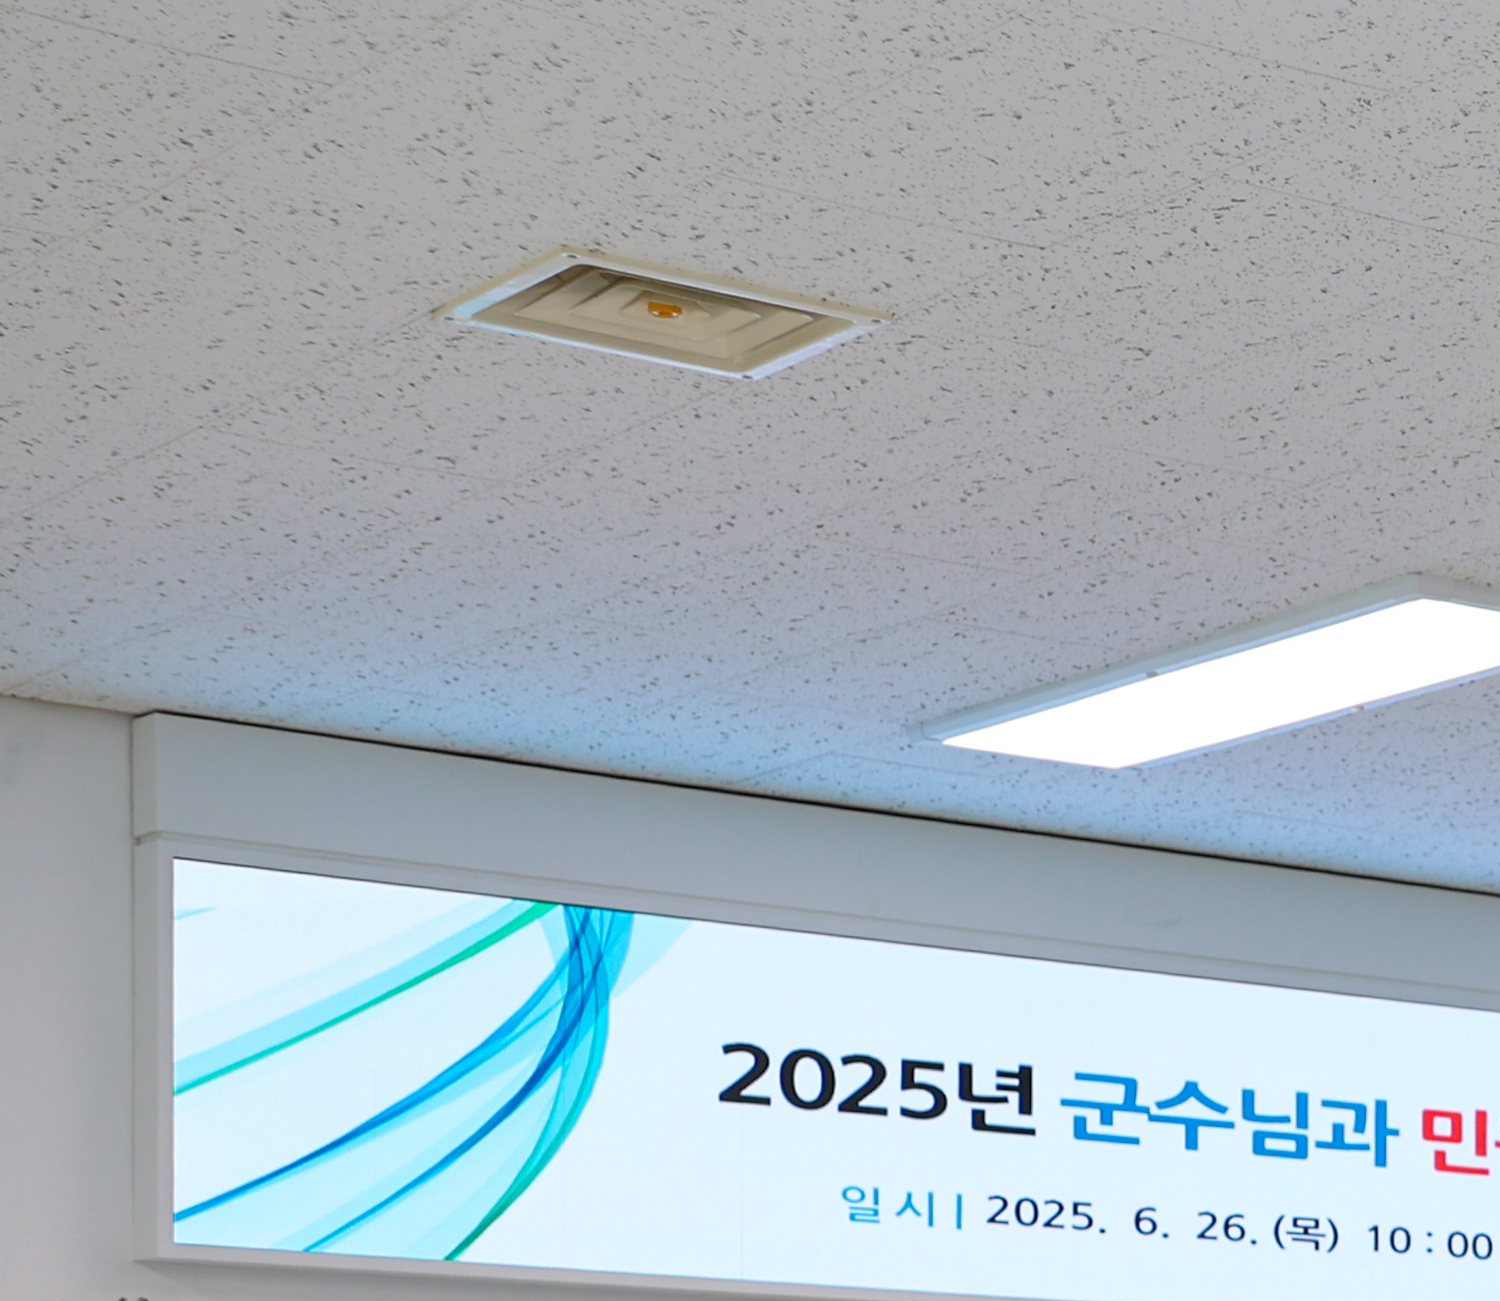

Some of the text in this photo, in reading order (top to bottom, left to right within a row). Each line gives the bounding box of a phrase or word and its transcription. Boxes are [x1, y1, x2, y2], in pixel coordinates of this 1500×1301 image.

[718, 1041, 1037, 1137] 2025년
[1059, 1071, 1401, 1169] 군수님과
[986, 1194, 1106, 1234] 2025.
